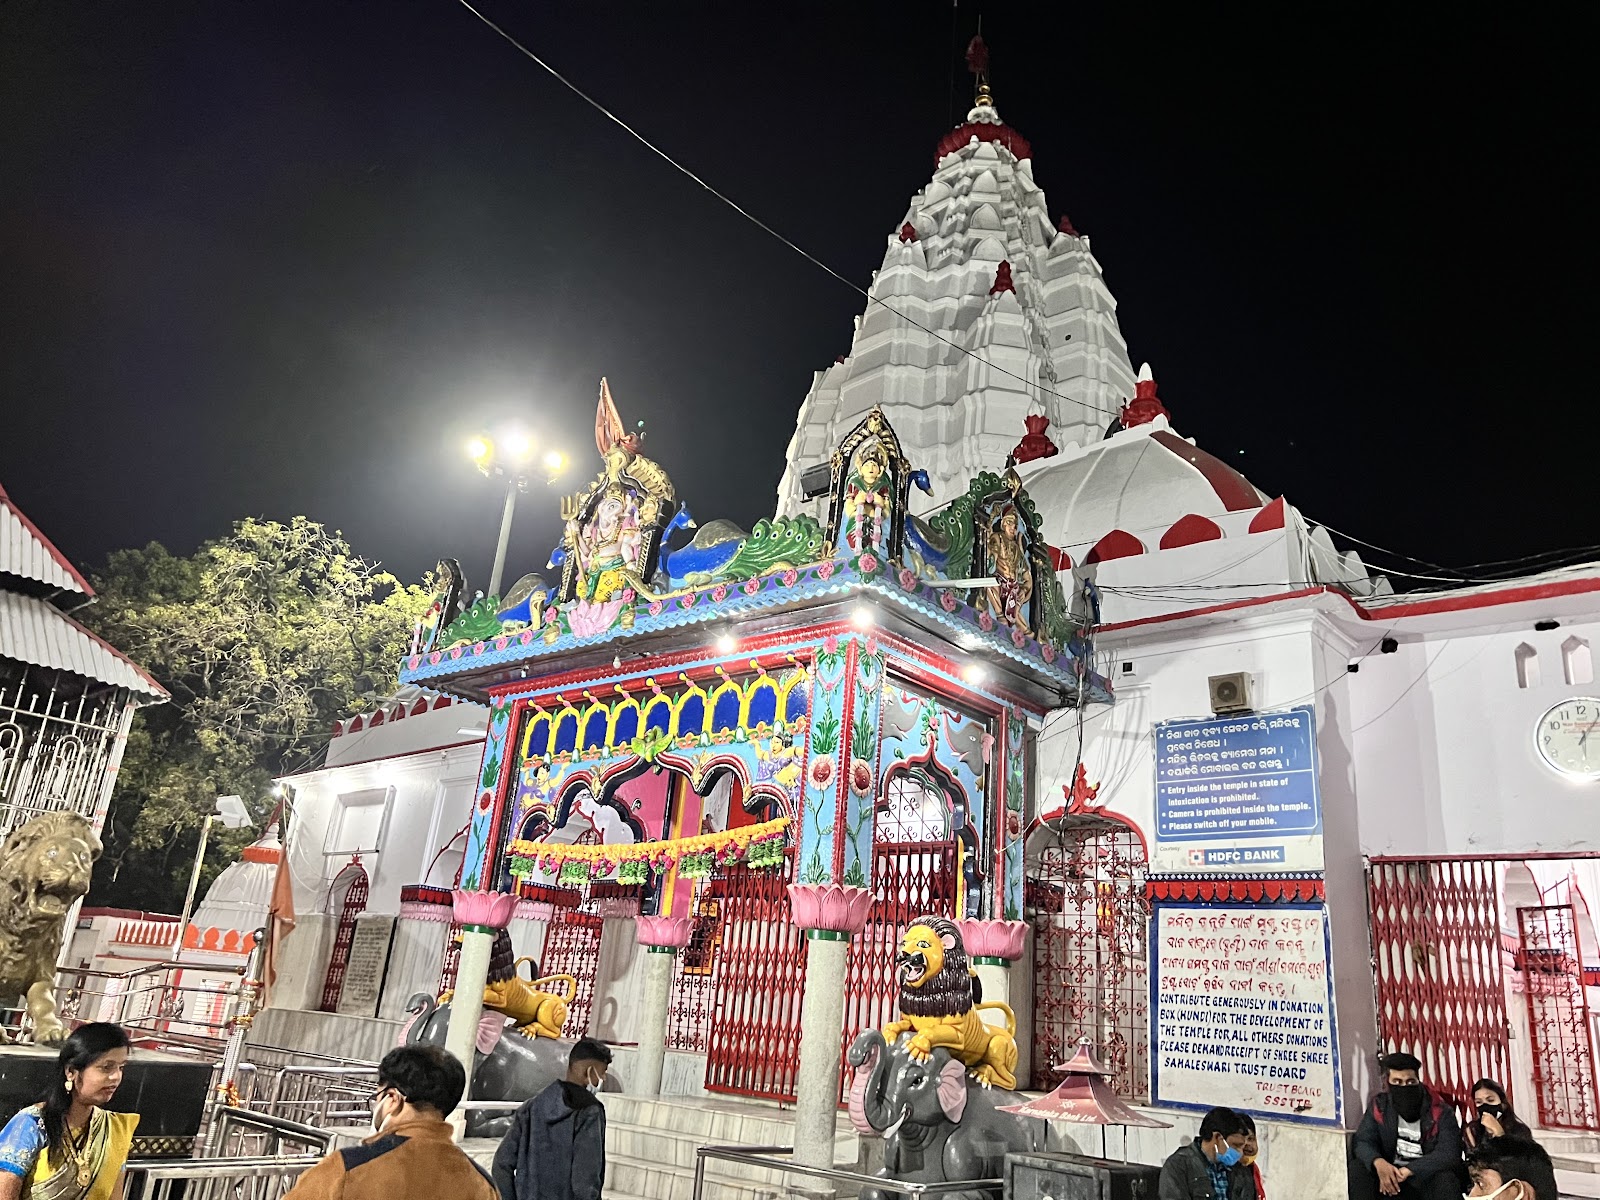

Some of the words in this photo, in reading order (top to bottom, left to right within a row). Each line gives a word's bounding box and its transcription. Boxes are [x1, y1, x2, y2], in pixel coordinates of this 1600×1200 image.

[1560, 711, 1569, 720] 11
[1576, 705, 1587, 715] 12
[1550, 721, 1561, 730] 10
[1544, 736, 1552, 745] 9
[1167, 786, 1185, 795] Entry
[1187, 785, 1209, 793] inside
[1210, 783, 1222, 791] the
[1223, 781, 1249, 790] temple
[1250, 780, 1257, 788] in
[1259, 779, 1279, 787] state
[1280, 777, 1289, 786] of
[1211, 795, 1218, 803] is
[1219, 793, 1260, 804] prohibited.
[1168, 810, 1195, 818] Camera
[1196, 808, 1203, 817] is
[1204, 805, 1241, 817] prohibited
[1267, 803, 1280, 812] the
[1281, 802, 1312, 812] temple.
[1168, 822, 1193, 830] Please
[1193, 820, 1218, 829] switch
[1219, 819, 1230, 828] off
[1231, 819, 1247, 829] your
[1248, 817, 1277, 826] mobile.
[1208, 851, 1241, 862] HDFC
[1244, 850, 1280, 861] BANK
[1160, 993, 1211, 1007] CONTRIBUTE
[1212, 996, 1266, 1010] GENEROUSLY
[1268, 998, 1278, 1011] IN
[1280, 1000, 1324, 1014] DONATION
[1160, 1009, 1176, 1020] BOX
[1230, 1013, 1248, 1026] THE
[1249, 1014, 1312, 1030] DEVELOPMENT
[1313, 1019, 1324, 1031] OF
[1160, 1024, 1176, 1036] THE
[1179, 1025, 1211, 1039] TEMPLE
[1251, 1031, 1285, 1045] OTHERS
[1286, 1033, 1329, 1048] DONATIONS
[1160, 1040, 1190, 1053] PLEASE
[1263, 1048, 1272, 1060] OF
[1273, 1049, 1299, 1062] SHREE
[1301, 1051, 1329, 1065] SHREE
[1234, 1063, 1267, 1077] TRUST
[1269, 1065, 1307, 1080] BOARD
[1256, 1081, 1290, 1094] TRUST
[1291, 1085, 1322, 1097] BOARD
[1058, 1111, 1080, 1121] Bank
